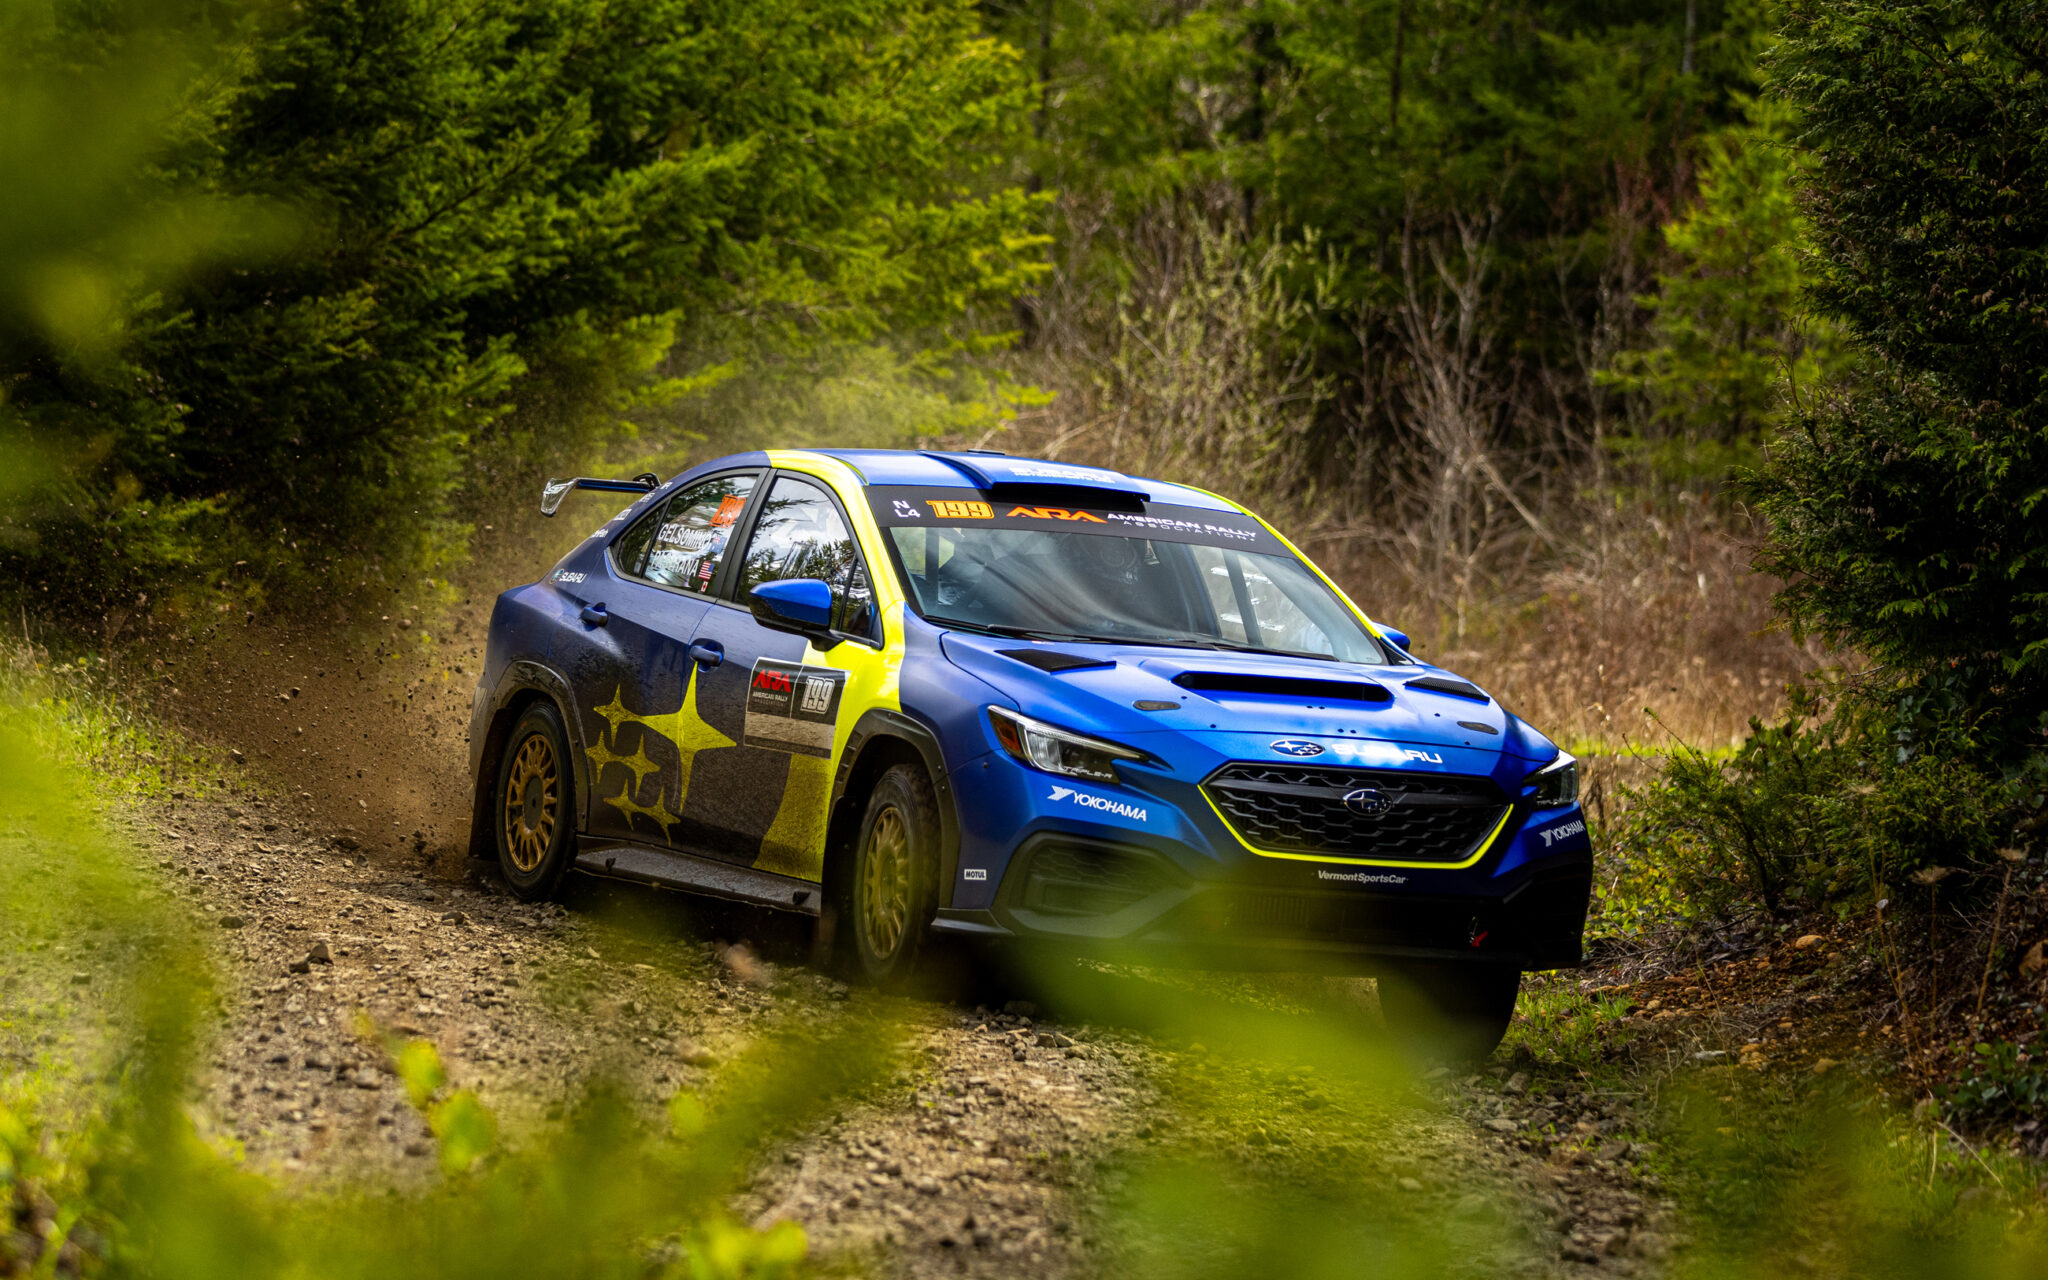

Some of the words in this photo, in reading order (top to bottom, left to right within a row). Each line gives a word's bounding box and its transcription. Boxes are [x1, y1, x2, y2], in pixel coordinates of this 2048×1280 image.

[892, 500, 911, 509] N
[894, 508, 920, 518] L4
[925, 500, 995, 519] 199
[1006, 506, 1108, 524] ARA
[1107, 513, 1201, 529] AMERICAN
[1204, 524, 1257, 538] RALLY
[1123, 520, 1247, 541] ASSOCIATION
[657, 523, 712, 551] GELSOMINO
[559, 571, 588, 583] SUBARU
[752, 669, 792, 693] ARA
[752, 691, 775, 701] AMERICAN
[775, 694, 788, 702] RALLY
[801, 676, 835, 714] 199
[1073, 791, 1147, 822] YOKOHAMA
[1551, 820, 1586, 841] YOKOHAMA
[965, 870, 985, 879] MOTUL
[1318, 870, 1406, 884] VermontSportsCar
